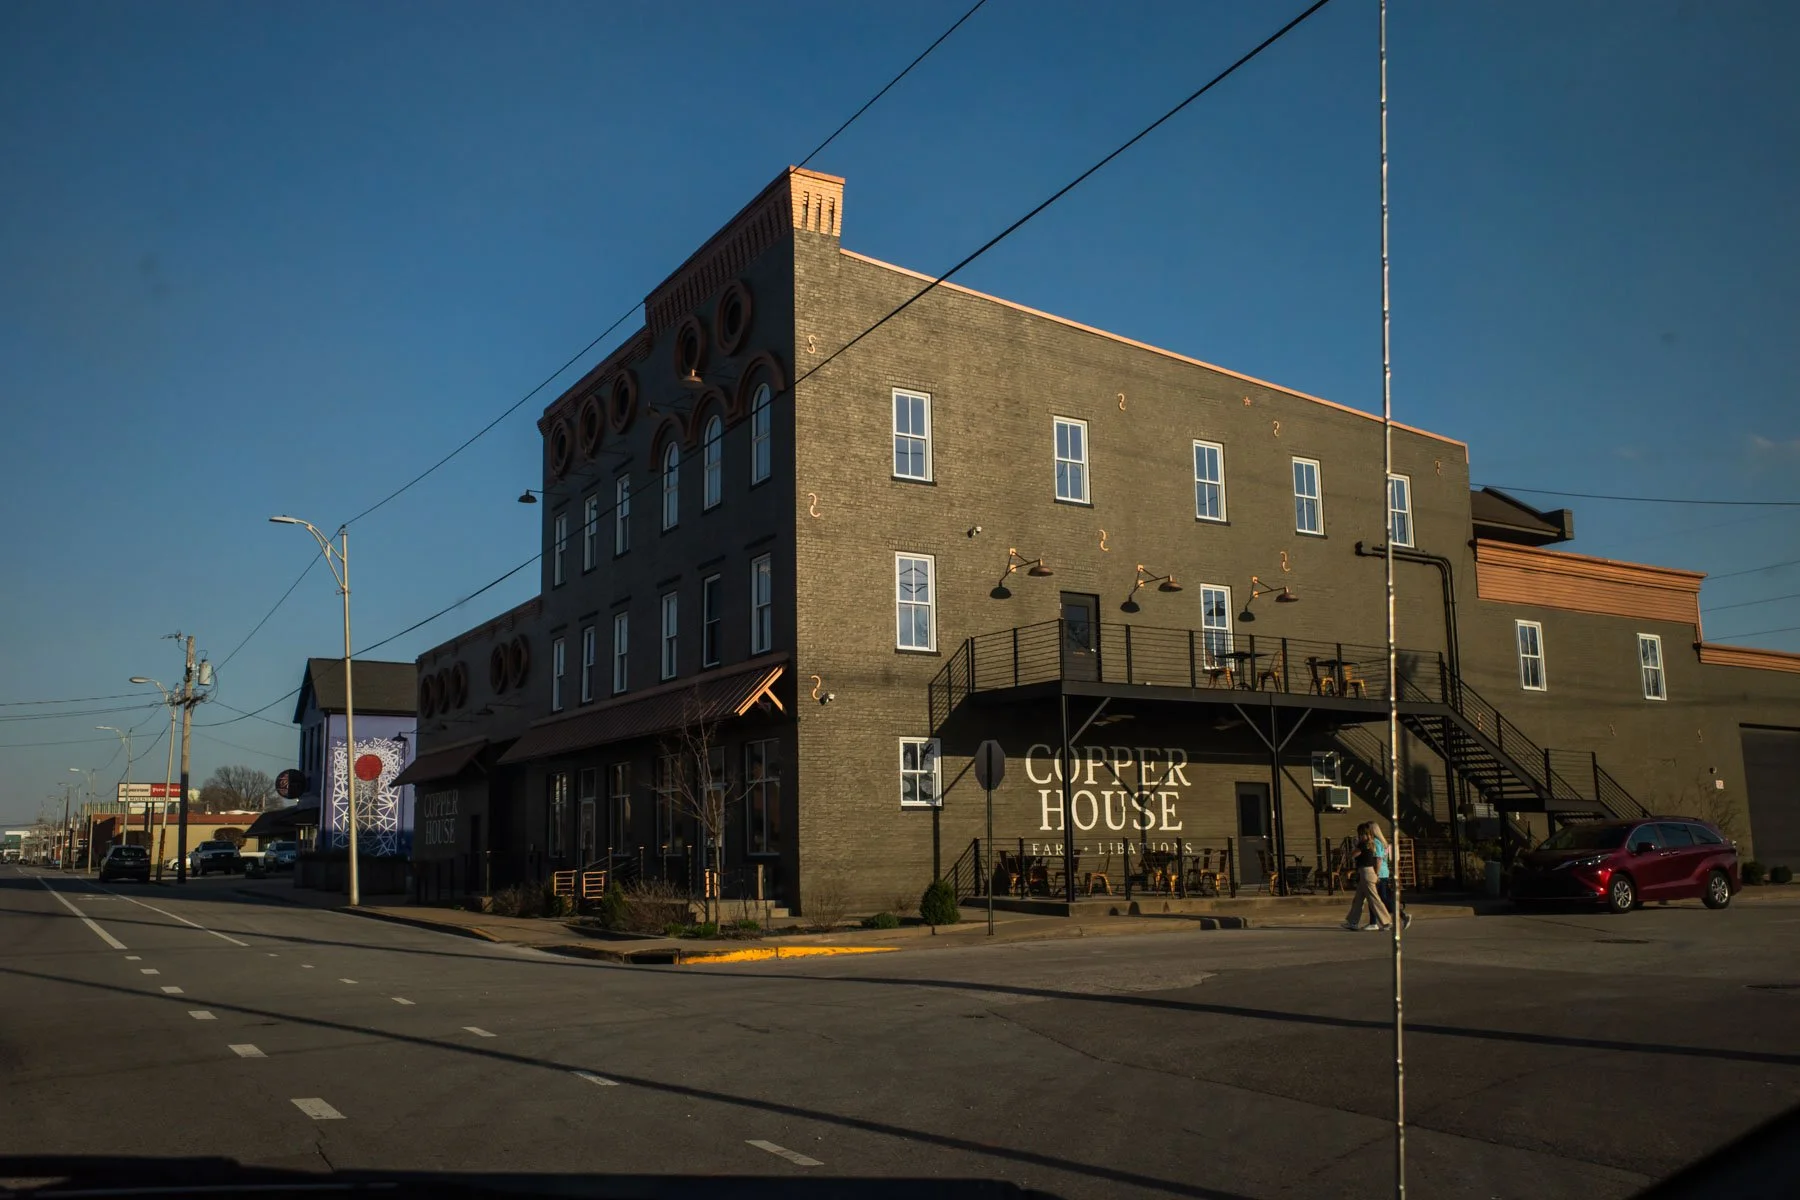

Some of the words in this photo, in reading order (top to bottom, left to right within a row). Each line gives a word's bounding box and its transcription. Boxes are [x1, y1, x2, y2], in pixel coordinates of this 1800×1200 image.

[1025, 743, 1192, 786] COPPER
[424, 789, 459, 818] COPPER
[1038, 790, 1182, 831] HOUSE
[425, 818, 456, 845] HOUSE
[1032, 843, 1073, 856] FAR
